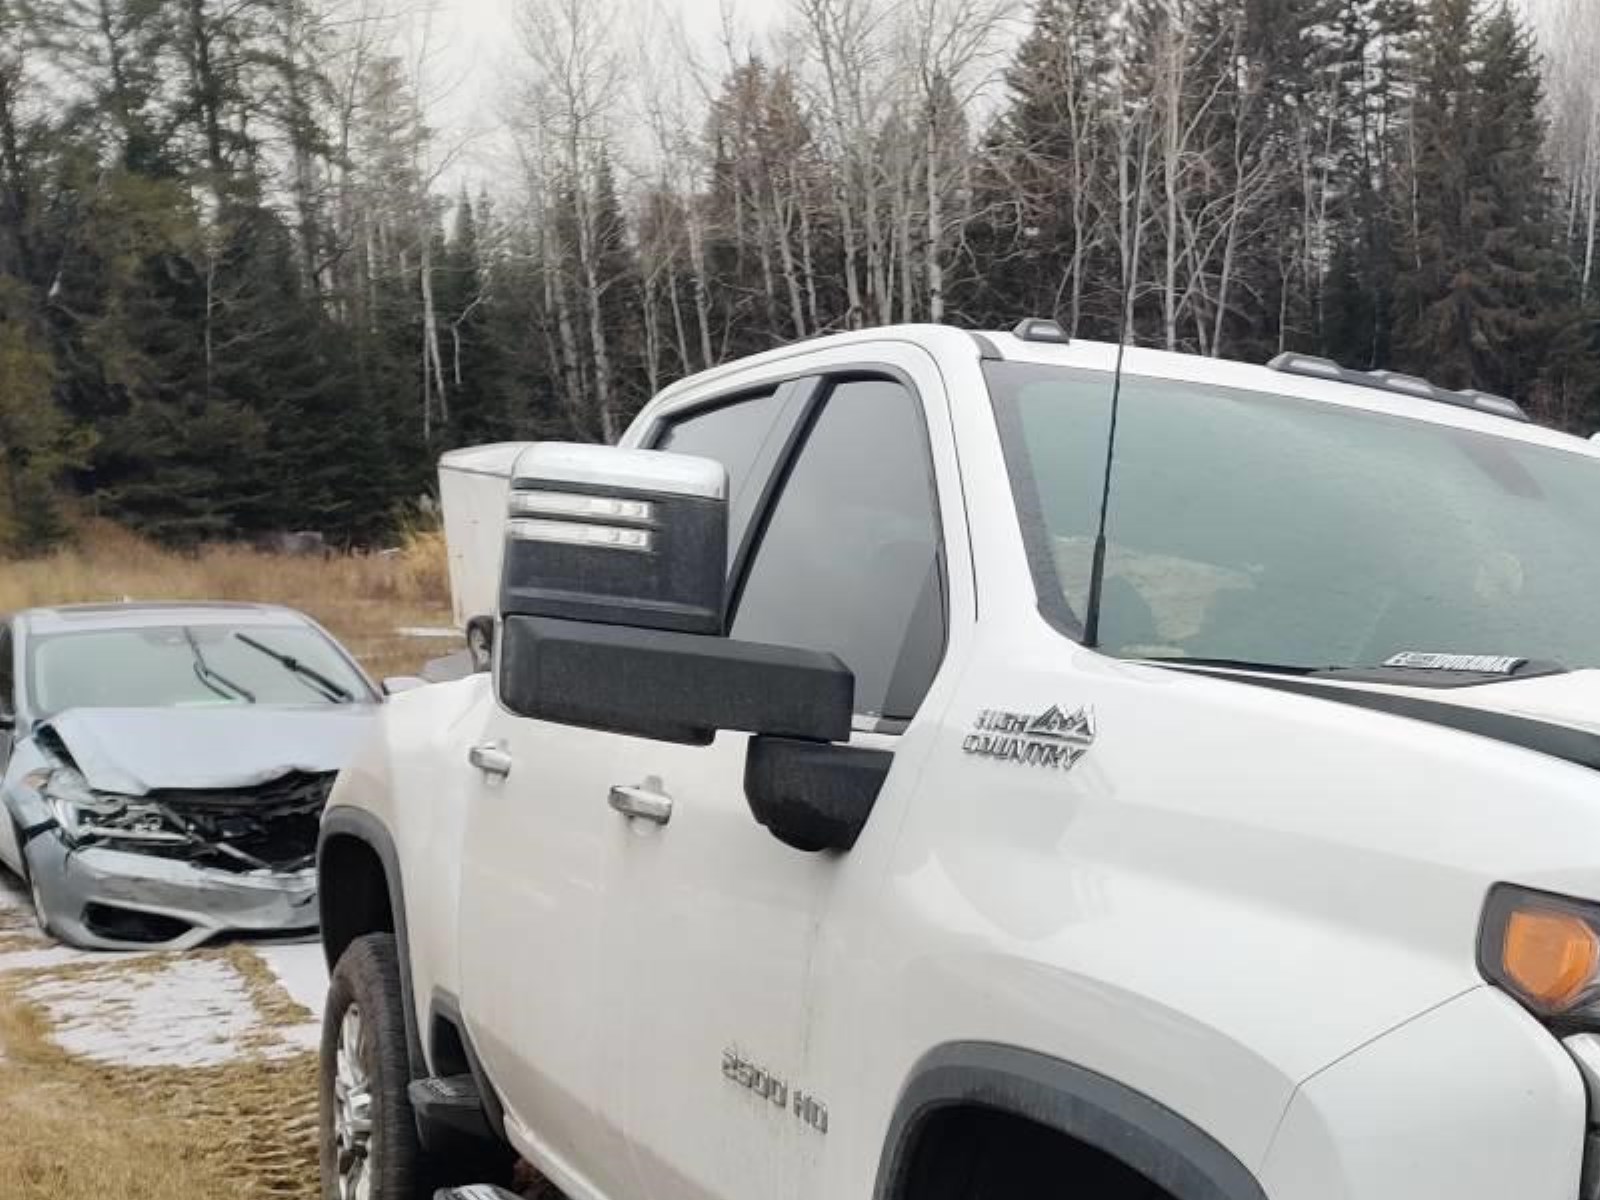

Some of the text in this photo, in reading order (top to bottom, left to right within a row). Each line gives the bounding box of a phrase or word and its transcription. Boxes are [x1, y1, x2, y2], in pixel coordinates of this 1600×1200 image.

[973, 708, 1031, 732] HIGH
[962, 734, 1088, 769] COUNTRY
[793, 1089, 828, 1135] HD
